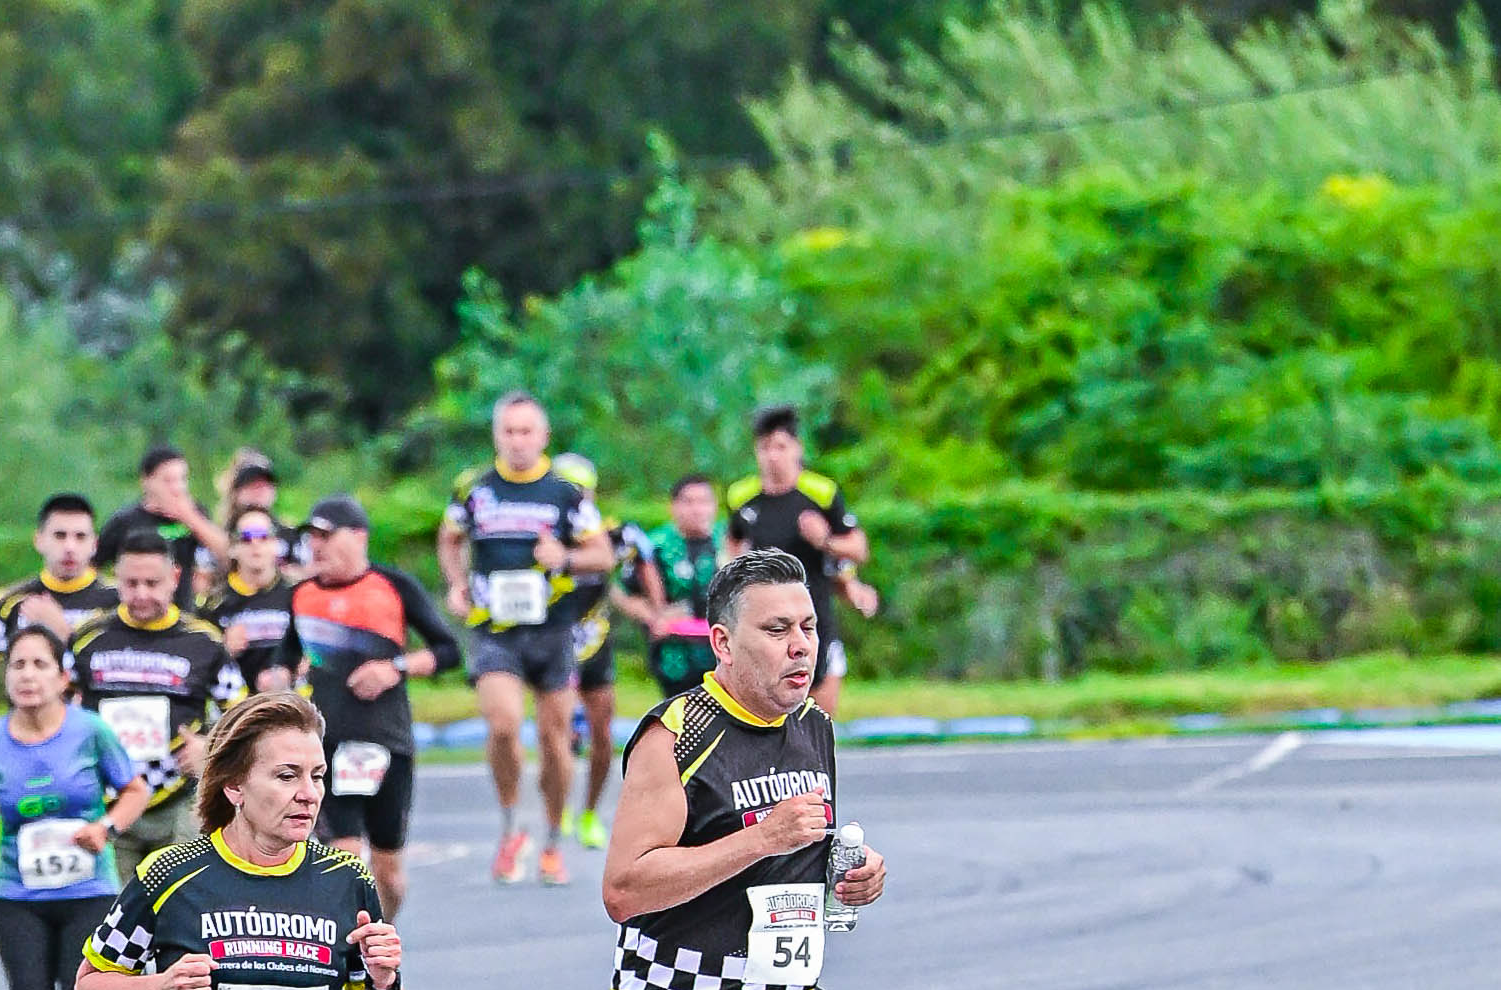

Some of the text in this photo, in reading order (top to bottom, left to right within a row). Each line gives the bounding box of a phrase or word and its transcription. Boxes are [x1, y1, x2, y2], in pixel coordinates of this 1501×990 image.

[731, 767, 832, 810] AUTÓDROMO
[33, 855, 80, 876] 152
[201, 905, 337, 945] AUTÓDROMO
[223, 940, 320, 961] RUNNING RACE
[773, 936, 810, 967] 54
[241, 960, 252, 970] de
